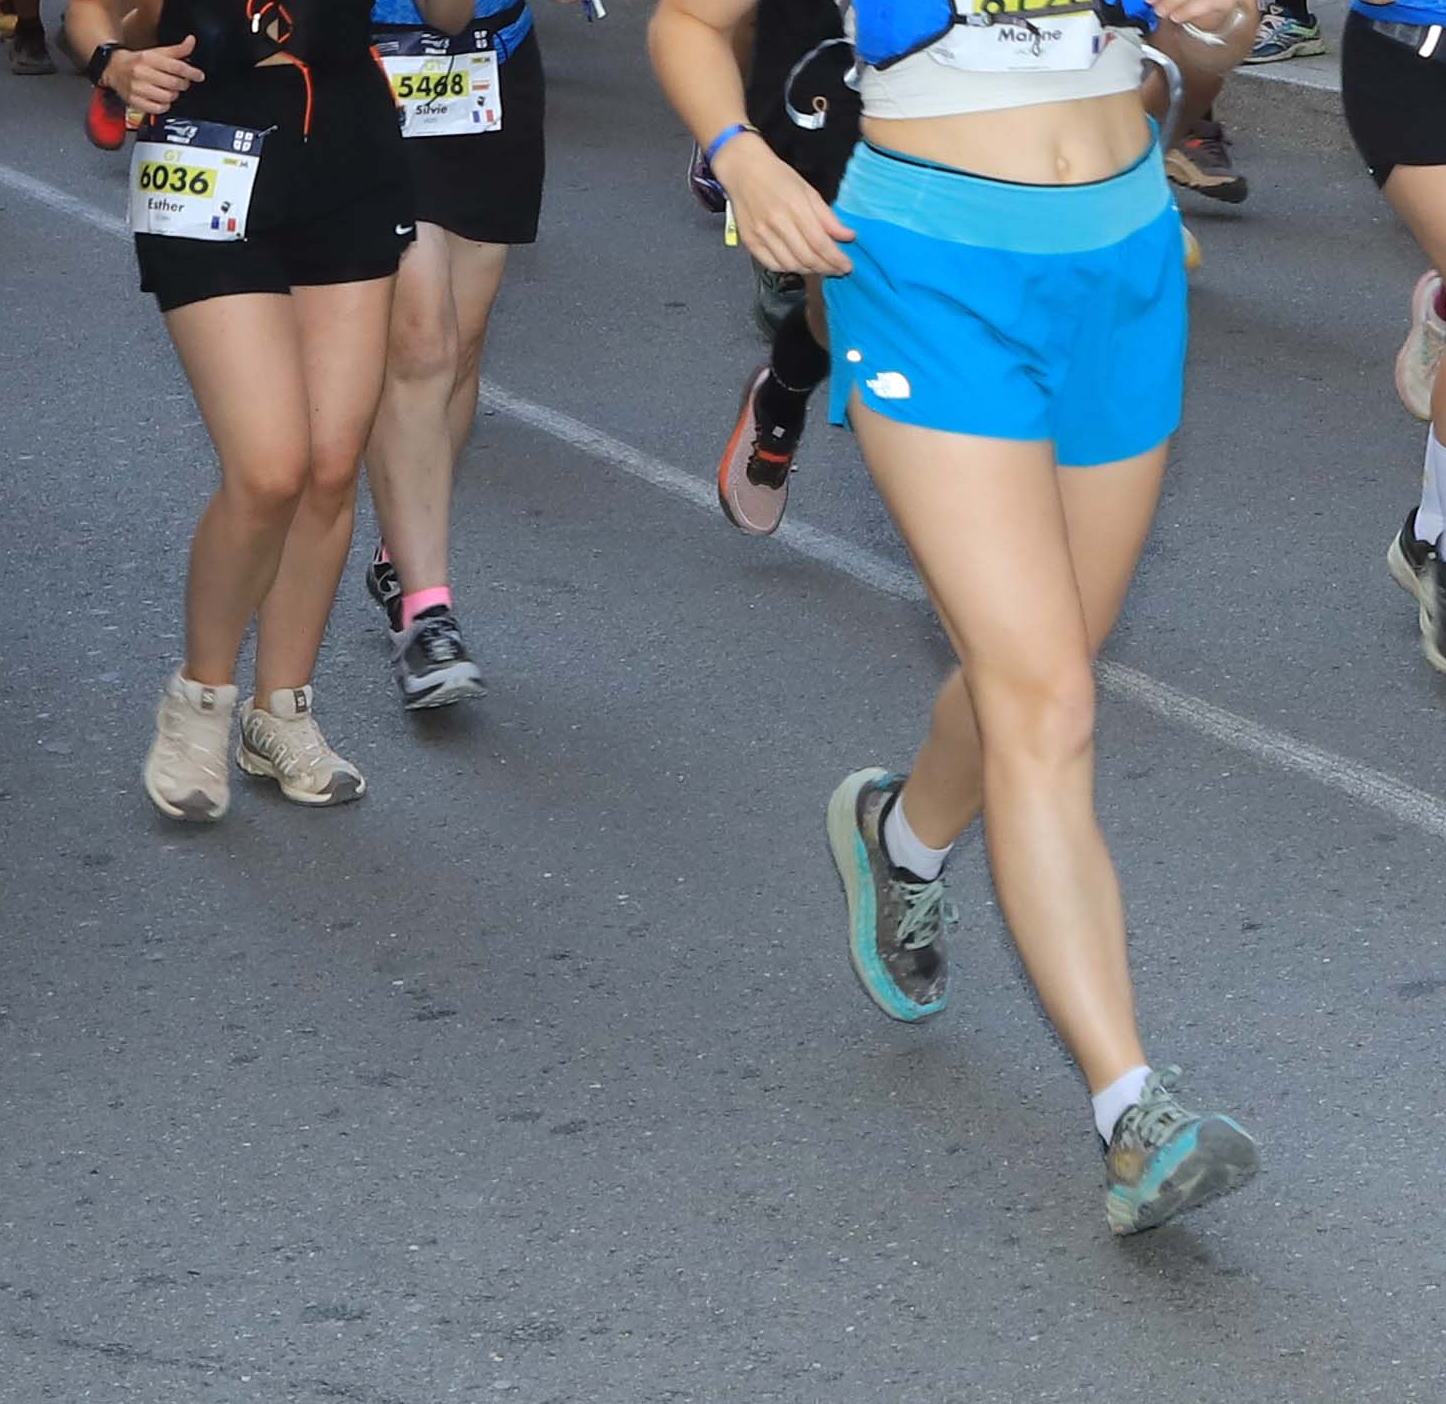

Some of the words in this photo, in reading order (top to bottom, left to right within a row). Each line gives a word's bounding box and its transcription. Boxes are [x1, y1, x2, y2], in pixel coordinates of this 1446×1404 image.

[998, 27, 1064, 43] Marne
[140, 165, 210, 195] 6036
[147, 197, 185, 213] Esther
